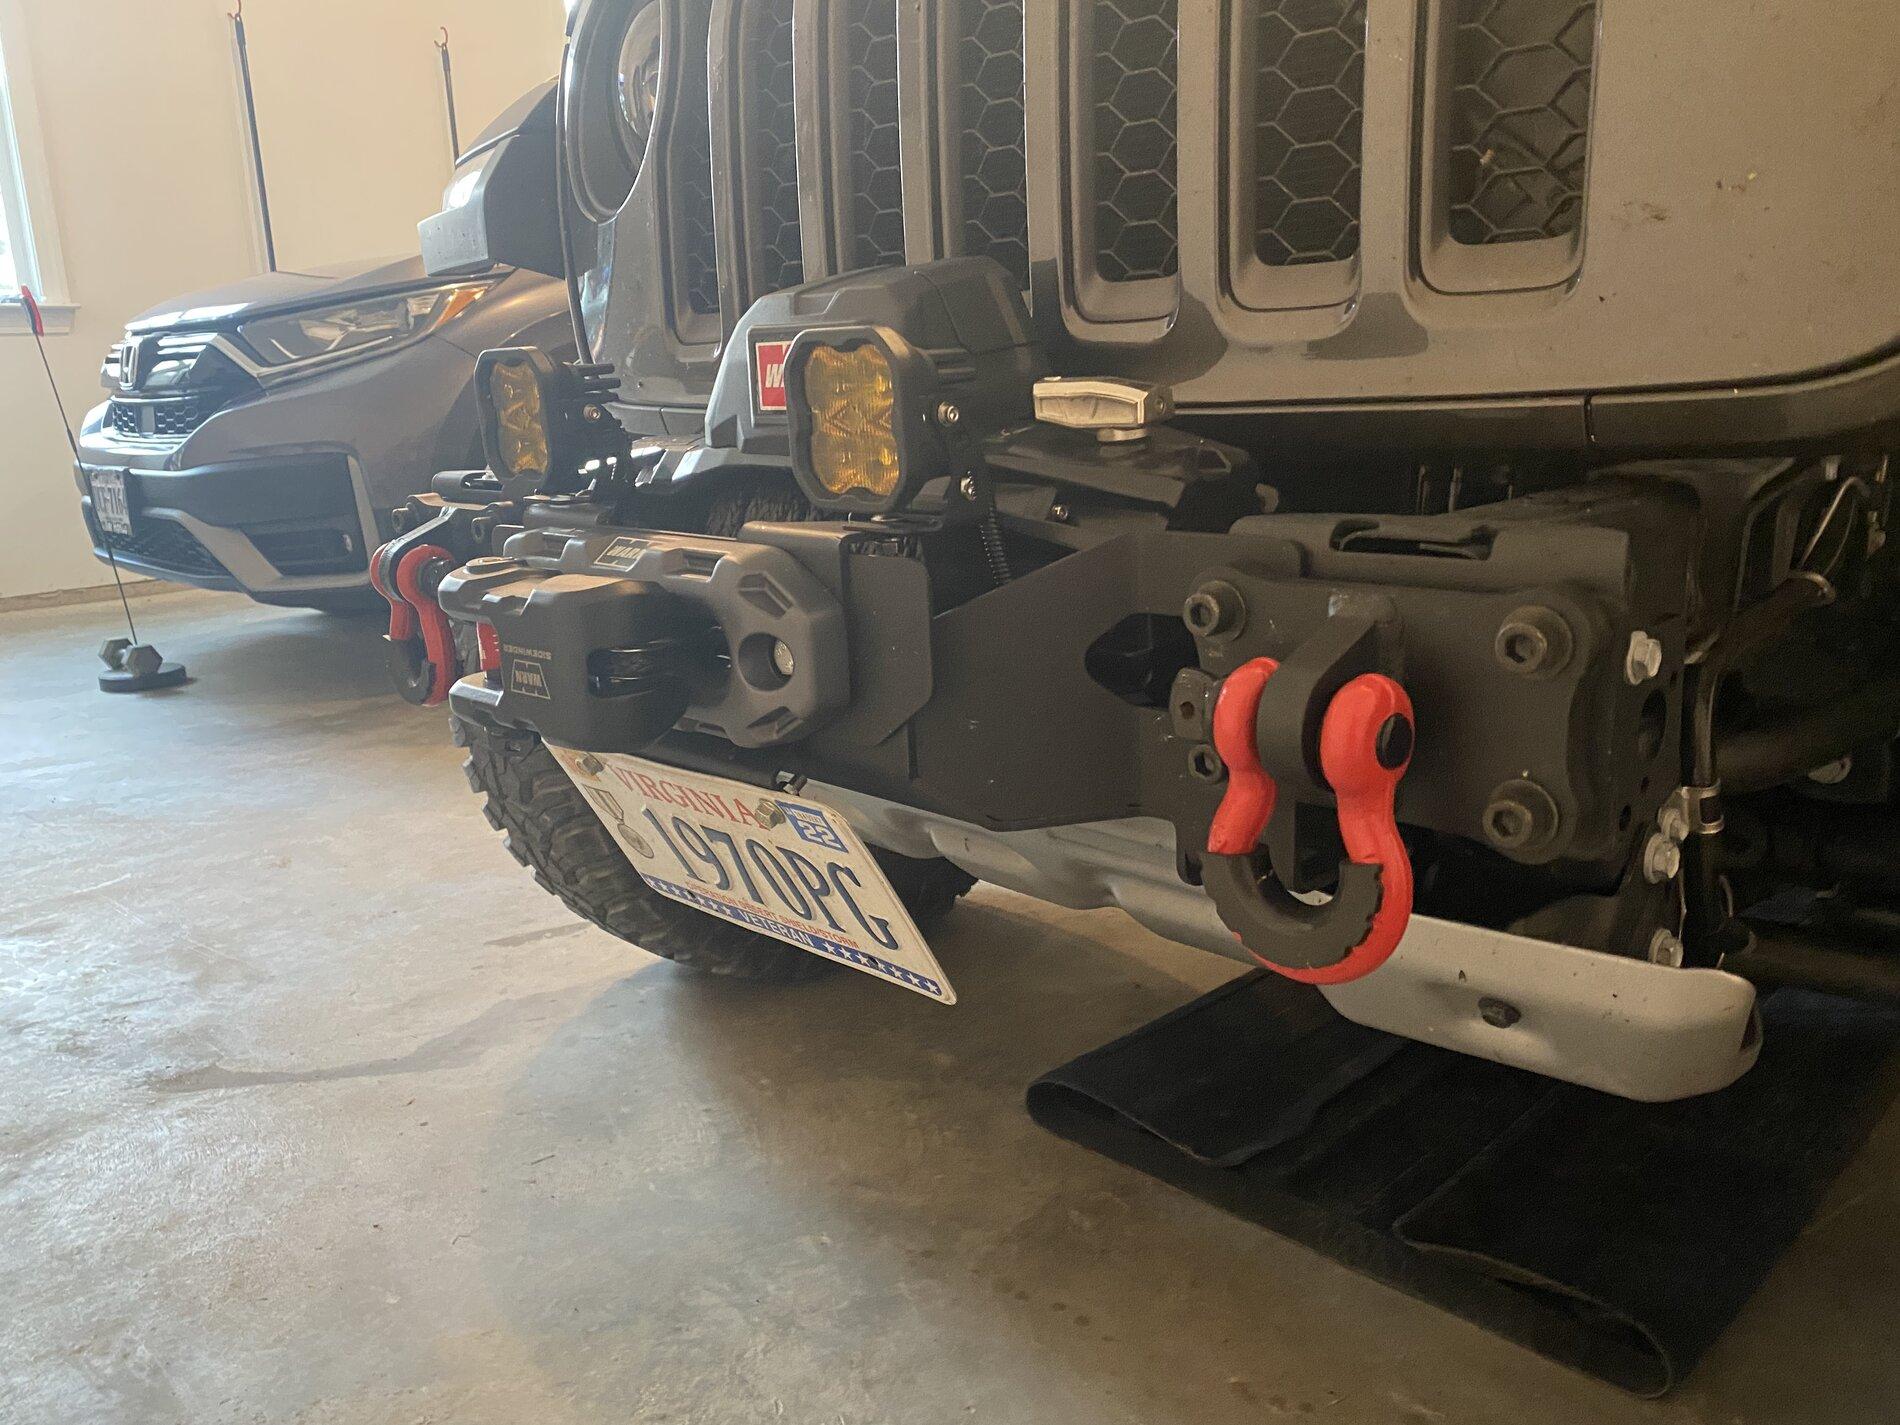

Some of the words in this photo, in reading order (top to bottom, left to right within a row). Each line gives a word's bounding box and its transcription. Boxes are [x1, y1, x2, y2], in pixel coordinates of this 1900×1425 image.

[503, 644, 552, 660] SIDEWINDER
[515, 670, 542, 687] WARN
[604, 763, 769, 829] VIRGINIA
[797, 821, 842, 848] 22
[641, 804, 900, 951] 1970PG
[685, 880, 740, 906] OPERATION
[742, 899, 782, 919] DESERT
[779, 915, 860, 948] SHIELD/STORM
[738, 909, 814, 947] VETERAN
